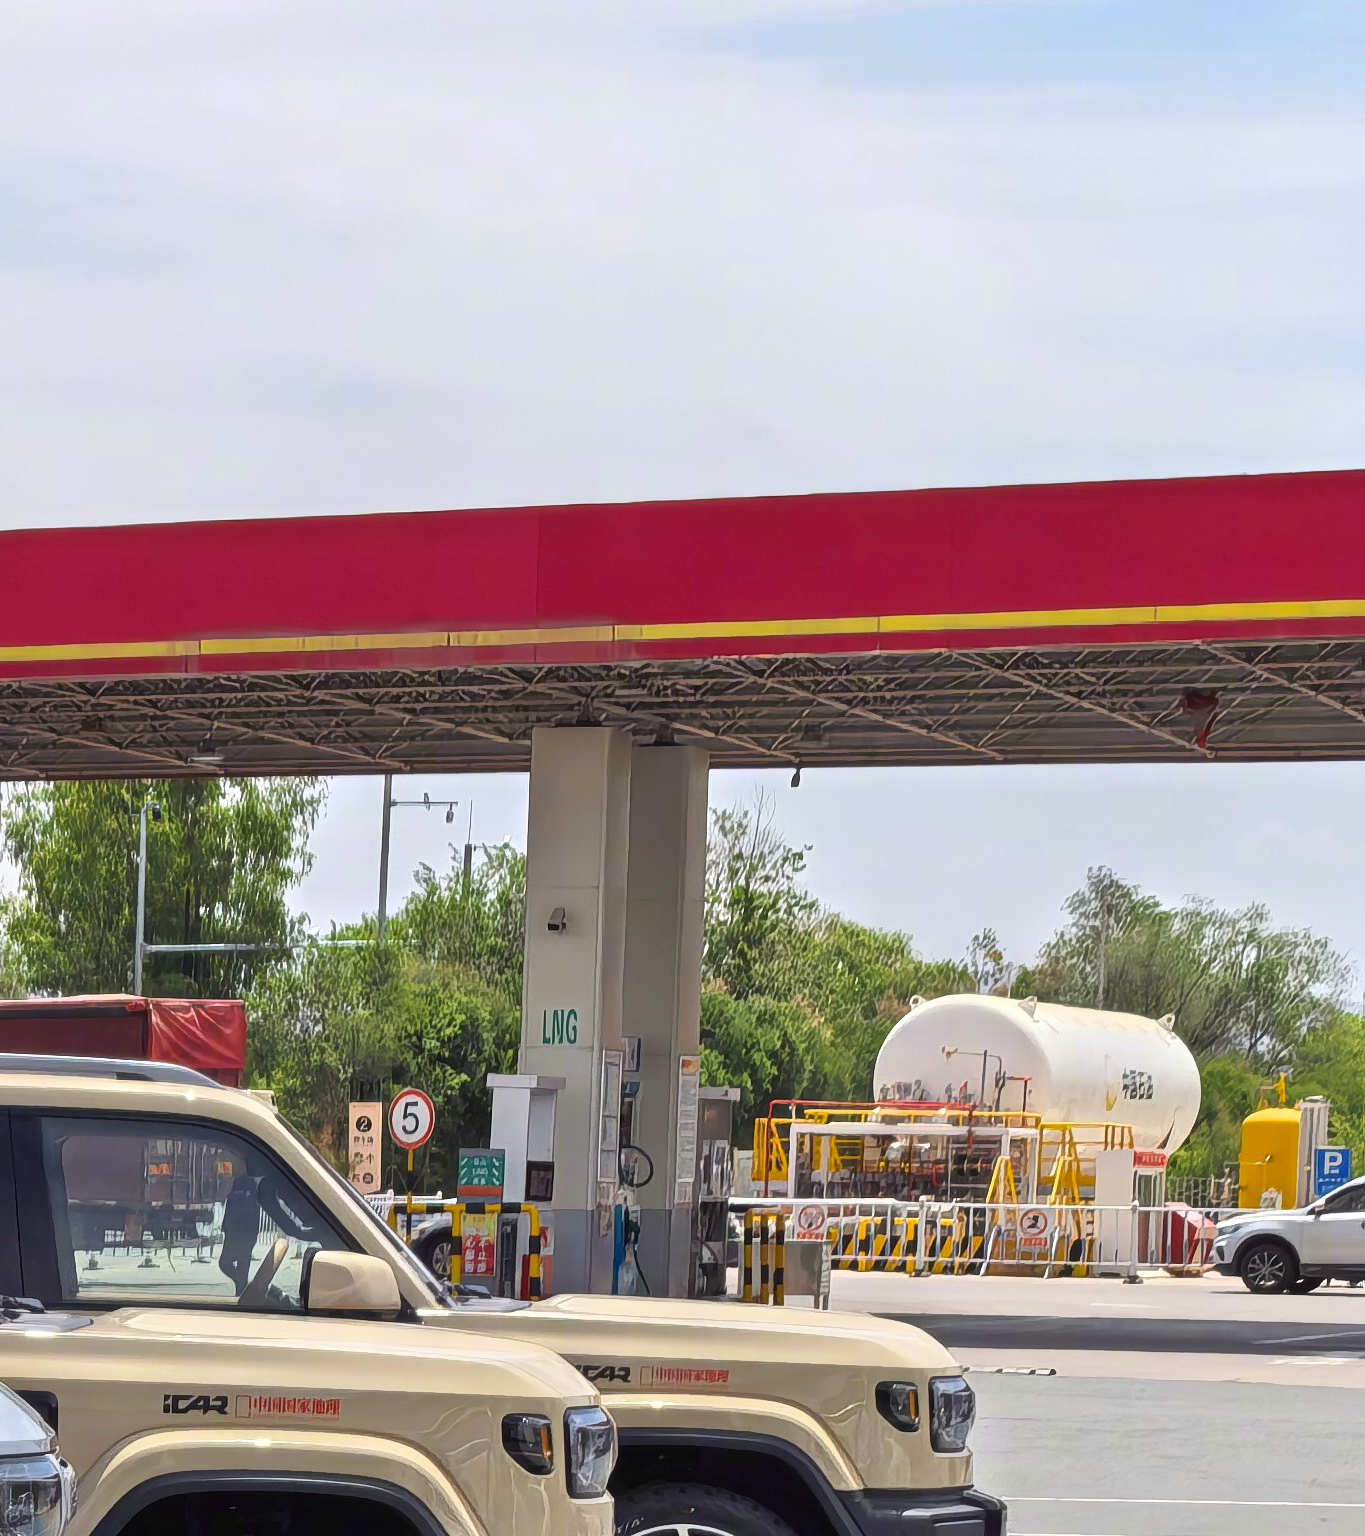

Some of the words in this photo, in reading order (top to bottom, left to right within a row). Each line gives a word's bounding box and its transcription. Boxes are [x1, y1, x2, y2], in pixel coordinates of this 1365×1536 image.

[542, 1008, 578, 1045] LNG
[401, 1101, 420, 1135] 5
[1323, 1151, 1343, 1175] P
